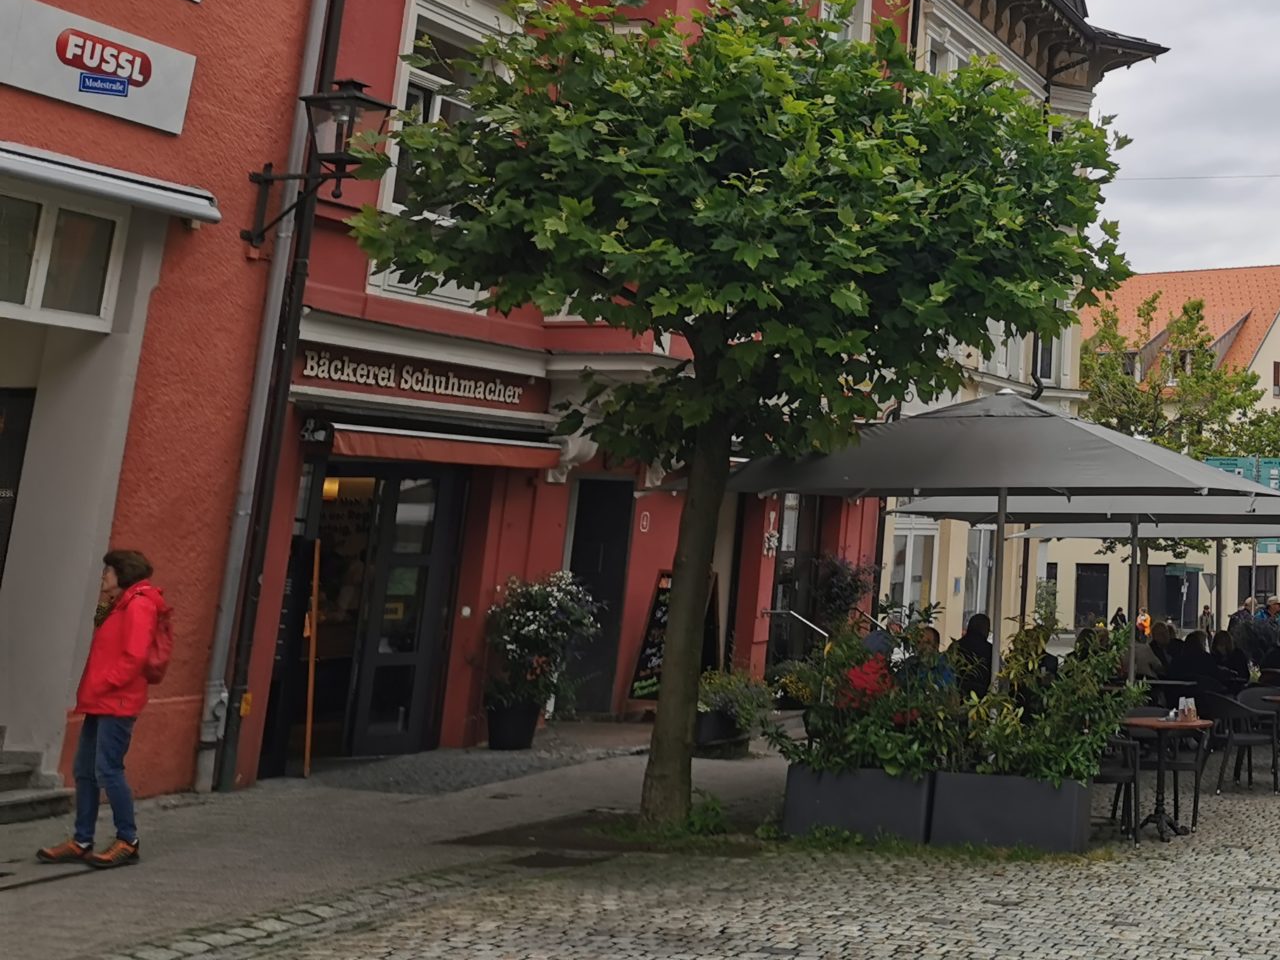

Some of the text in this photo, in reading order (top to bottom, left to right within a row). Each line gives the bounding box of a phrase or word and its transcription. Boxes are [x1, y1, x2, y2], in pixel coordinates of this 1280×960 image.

[65, 34, 144, 82] FUSSL
[84, 77, 125, 92] Modestraße
[303, 349, 523, 404] Bäckerei Schuhmacher
